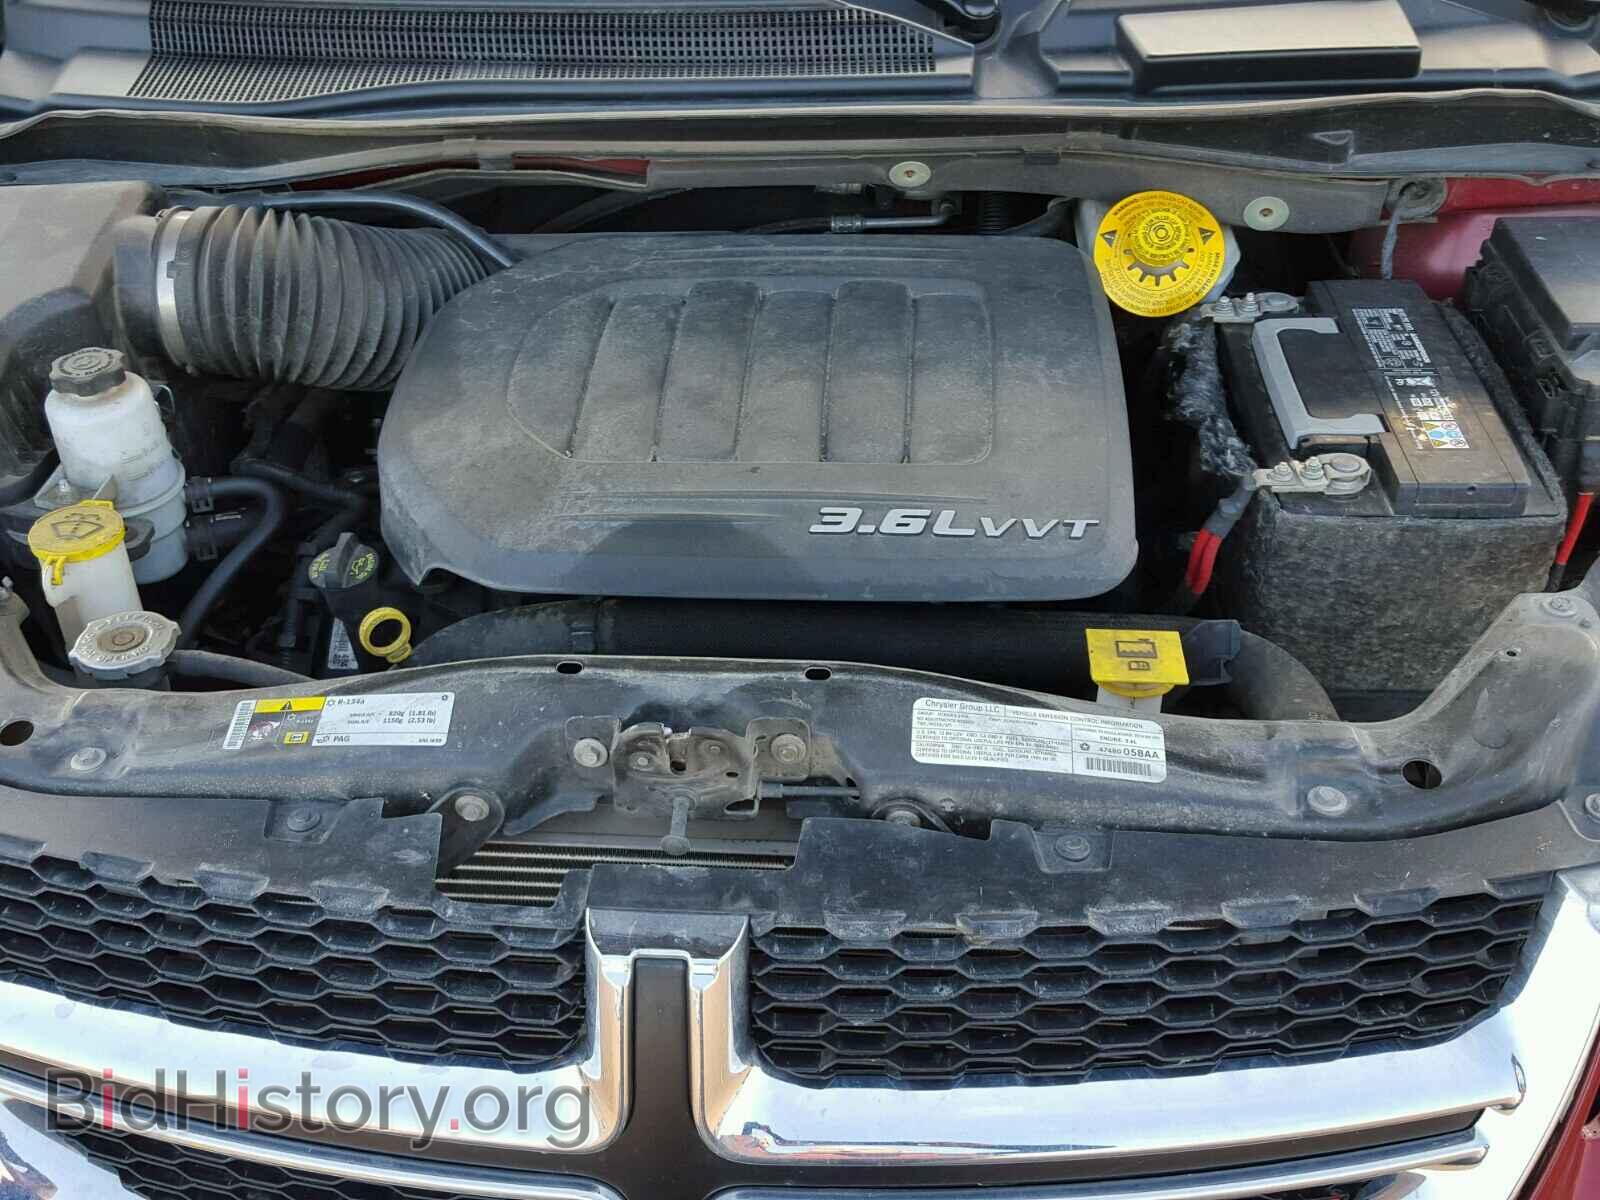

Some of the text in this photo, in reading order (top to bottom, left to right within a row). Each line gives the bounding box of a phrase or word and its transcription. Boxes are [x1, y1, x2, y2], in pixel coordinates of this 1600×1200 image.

[808, 506, 1100, 538] 3.6L VVT
[925, 699, 1000, 713] Chrysler Group LLC
